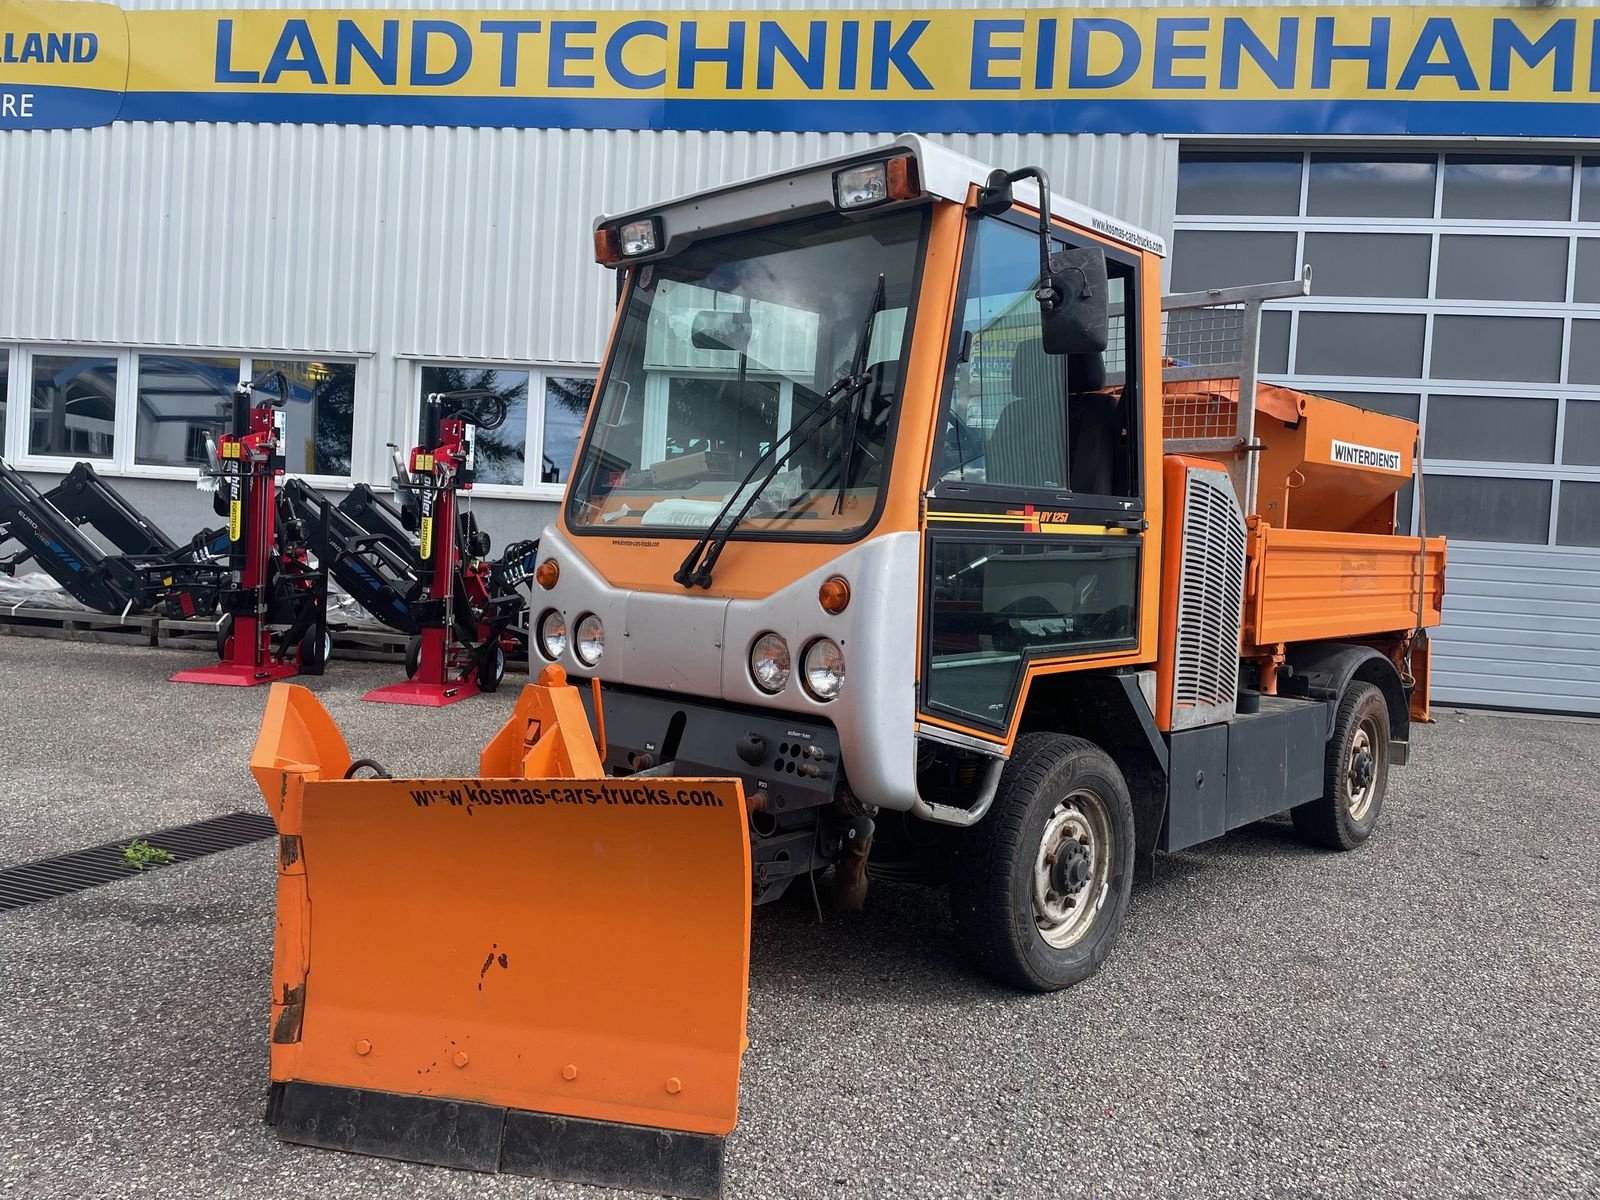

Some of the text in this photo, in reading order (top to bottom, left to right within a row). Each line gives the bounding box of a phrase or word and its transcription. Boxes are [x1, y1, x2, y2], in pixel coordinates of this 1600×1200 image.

[0, 33, 98, 63] LAND
[214, 17, 1600, 92] LANDTECHNIK EIDENHAM
[1091, 217, 1163, 253] www.kosmas-cars-trucks.com
[1334, 443, 1399, 469] WINTERDIENST
[18, 510, 38, 530] EURO
[421, 519, 429, 558] FORSTTECHNIK
[409, 783, 724, 808] wwkosmas-cars-trucks.com
